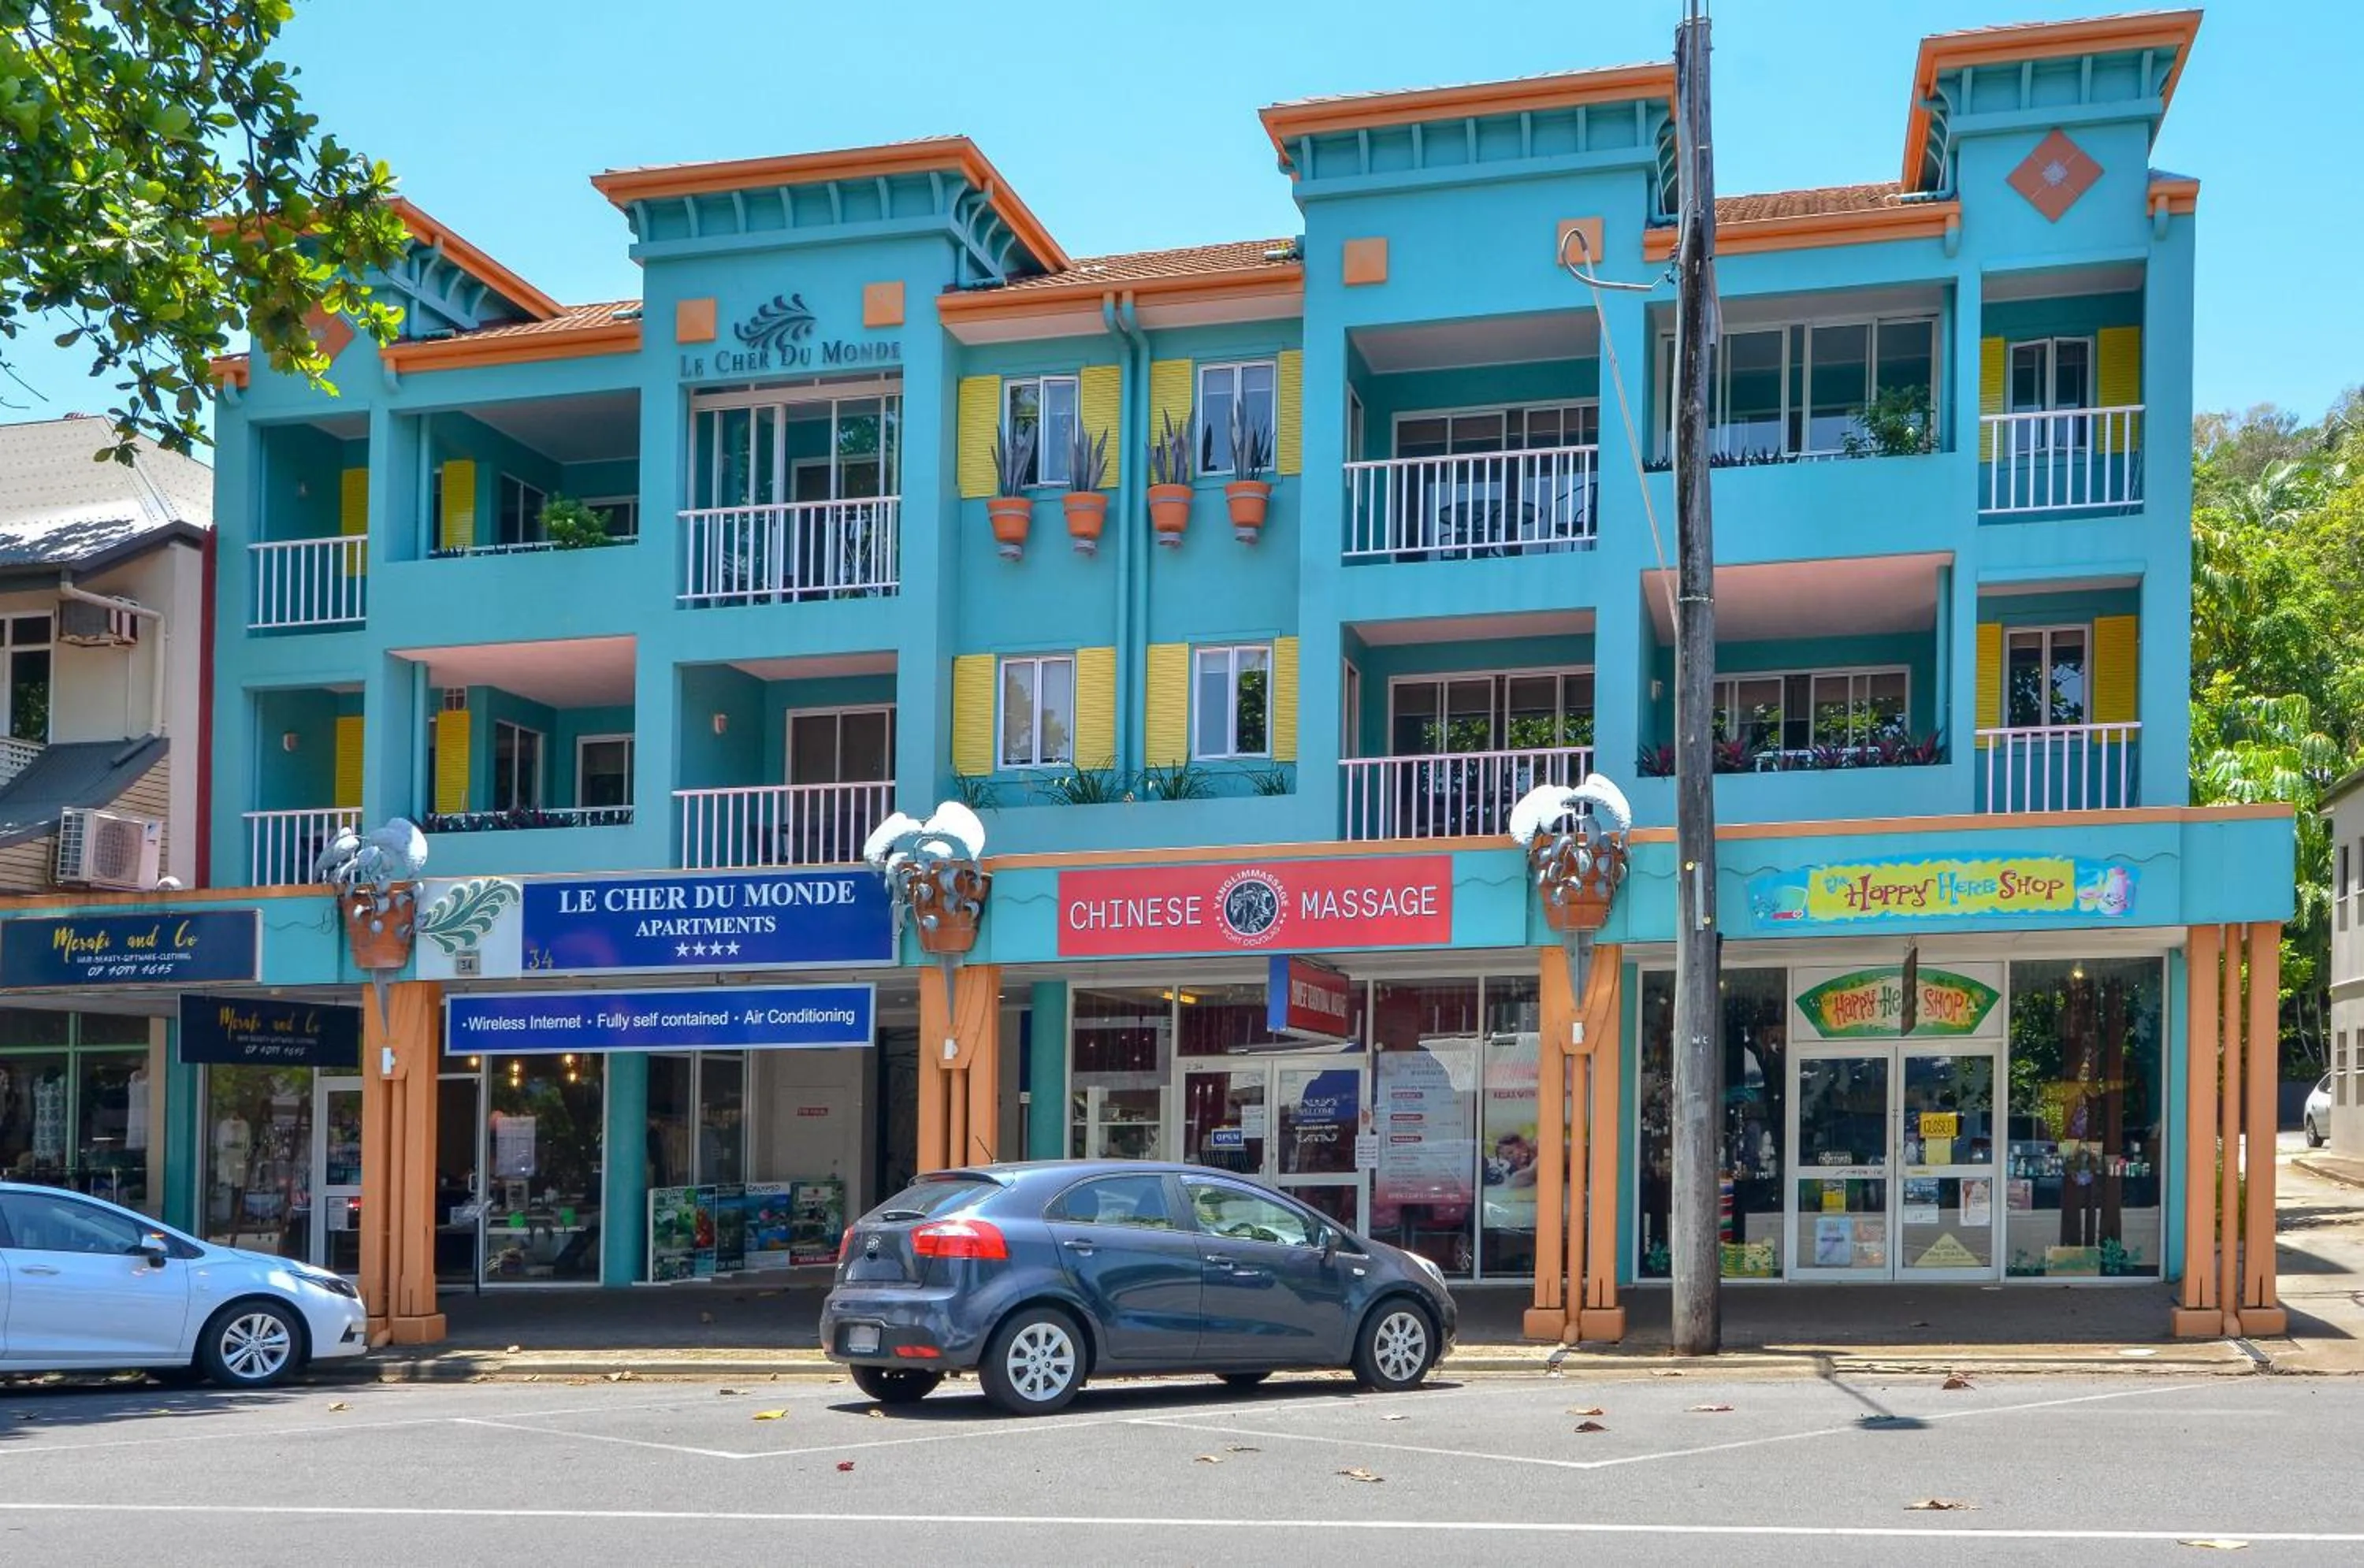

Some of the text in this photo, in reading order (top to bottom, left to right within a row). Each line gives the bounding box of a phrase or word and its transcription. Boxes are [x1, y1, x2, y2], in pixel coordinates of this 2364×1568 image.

[559, 880, 856, 913] LE CHER DU MONDE
[1301, 886, 1438, 920] MASSAGE
[1069, 896, 1202, 930] CHINESE
[127, 924, 161, 948] and
[175, 920, 197, 947] Co
[635, 916, 776, 937] APARTMENTS
[529, 948, 553, 971] 34
[468, 1007, 855, 1031] Wireless Internet Fully self contained Air Conditioning
[1216, 1134, 1240, 1143] OPEN
